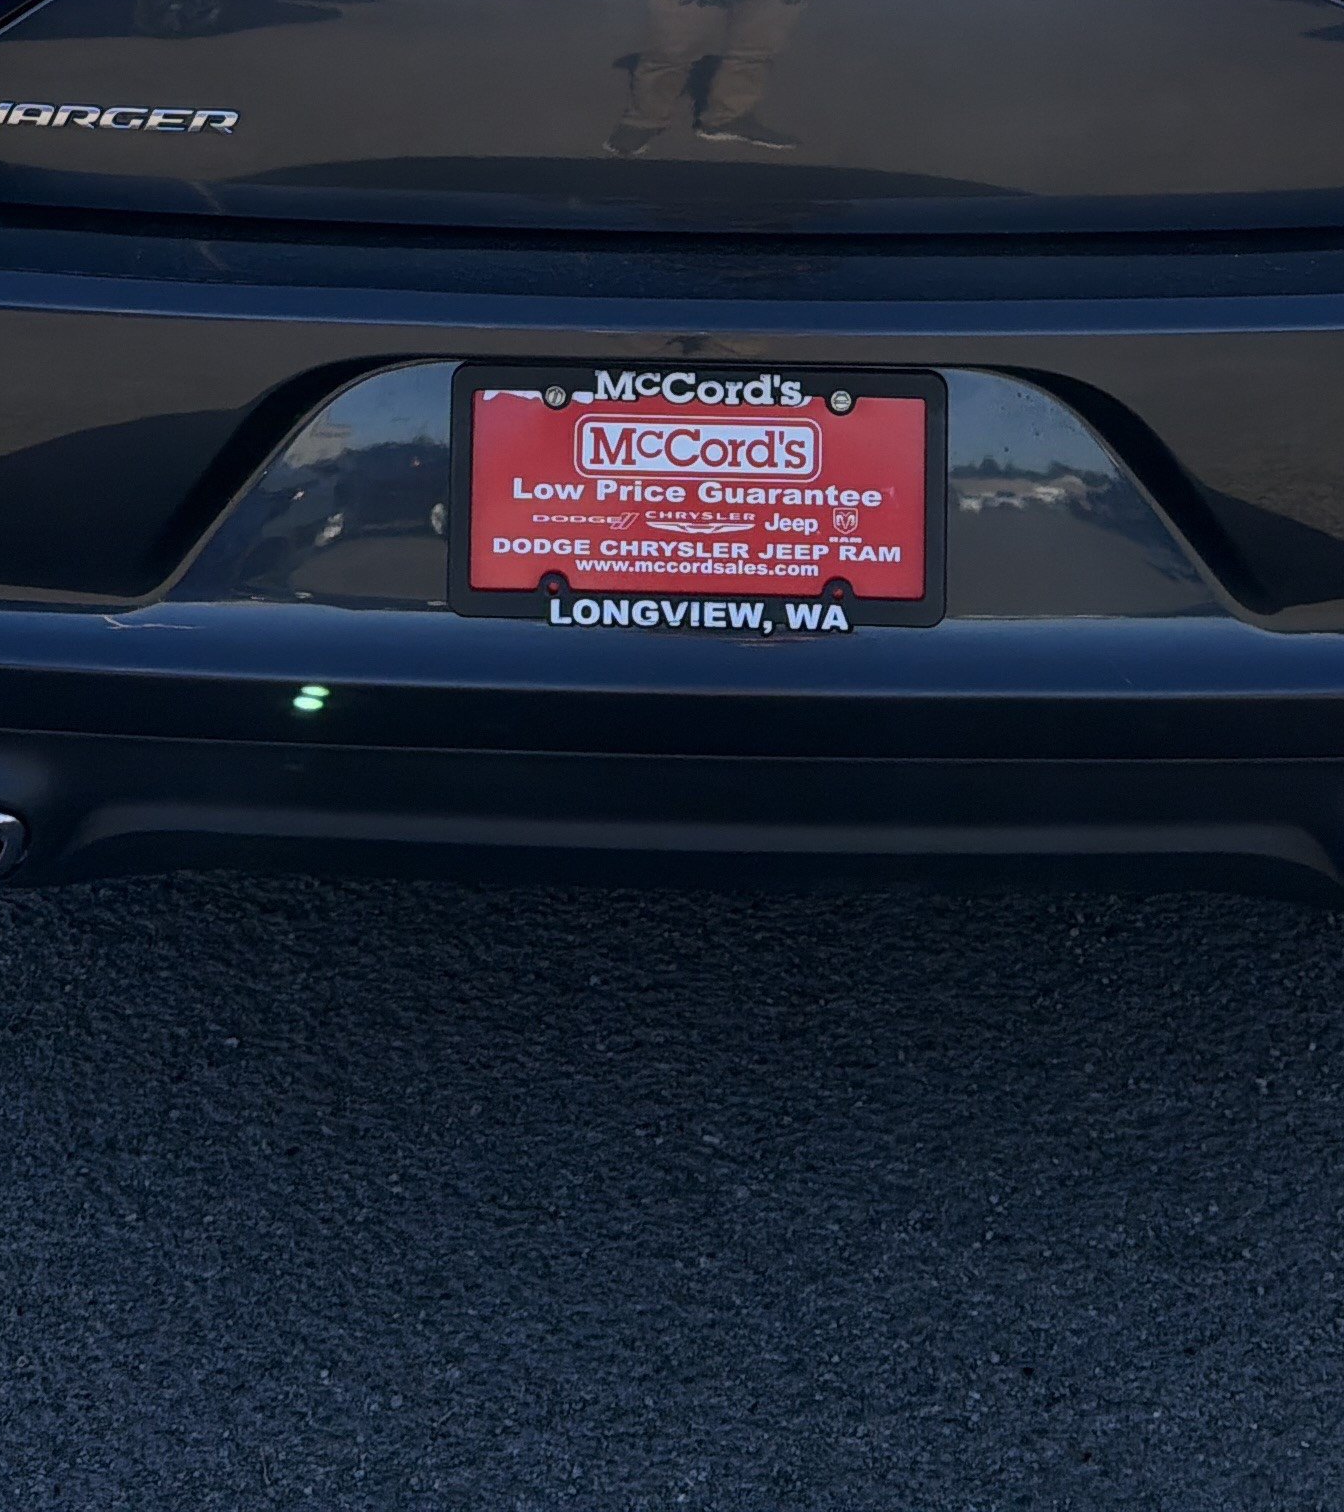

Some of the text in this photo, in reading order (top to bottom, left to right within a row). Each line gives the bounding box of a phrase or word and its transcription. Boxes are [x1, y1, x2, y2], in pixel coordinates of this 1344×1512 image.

[594, 370, 802, 406] McCord's
[589, 426, 807, 469] McCord's
[513, 477, 883, 507] Low Price Guarantee
[532, 510, 819, 535] DODGE CHRYSLER Jeep
[492, 537, 902, 563] DODGE CHRYSLER JEEP RAM
[575, 559, 820, 577] www.mccordsales.com
[550, 598, 849, 634] LONGVIEW, WA
